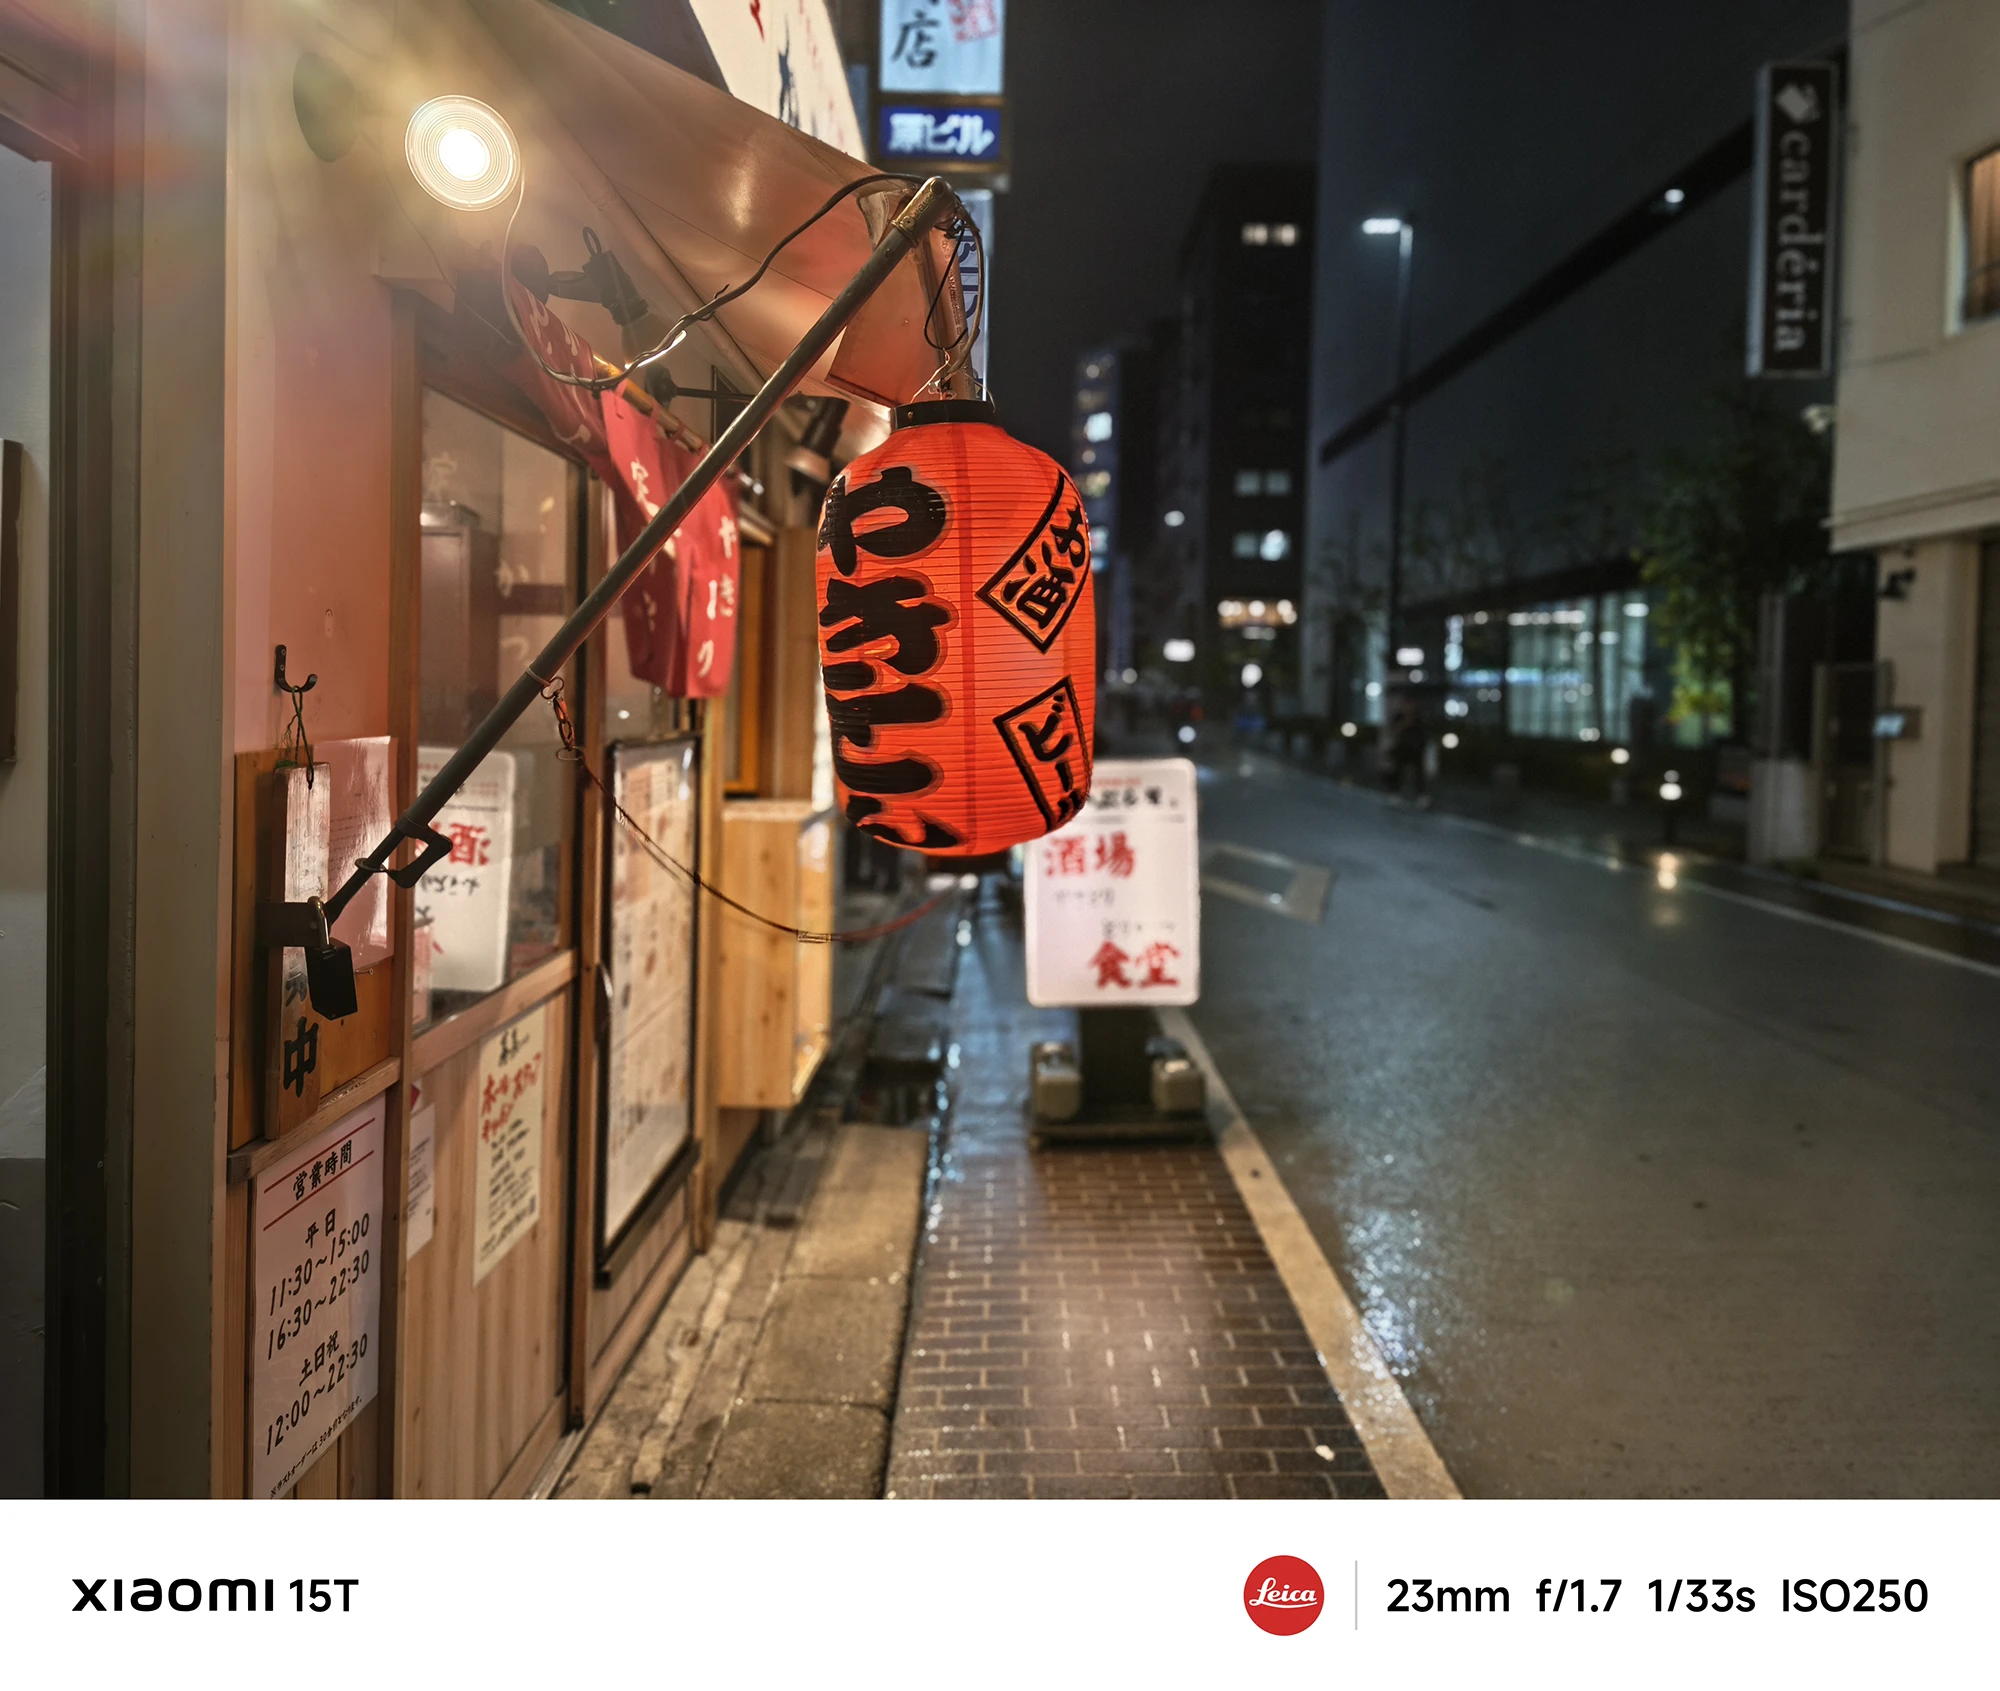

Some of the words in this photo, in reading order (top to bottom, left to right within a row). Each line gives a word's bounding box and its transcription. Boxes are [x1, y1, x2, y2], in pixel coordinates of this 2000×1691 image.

[891, 0, 941, 68] 店
[1044, 830, 1135, 878] 酒場
[1087, 941, 1182, 989] 食堂
[292, 1139, 353, 1201] 営業時間
[304, 1208, 337, 1249] 平日
[298, 1330, 340, 1387] 土日祝
